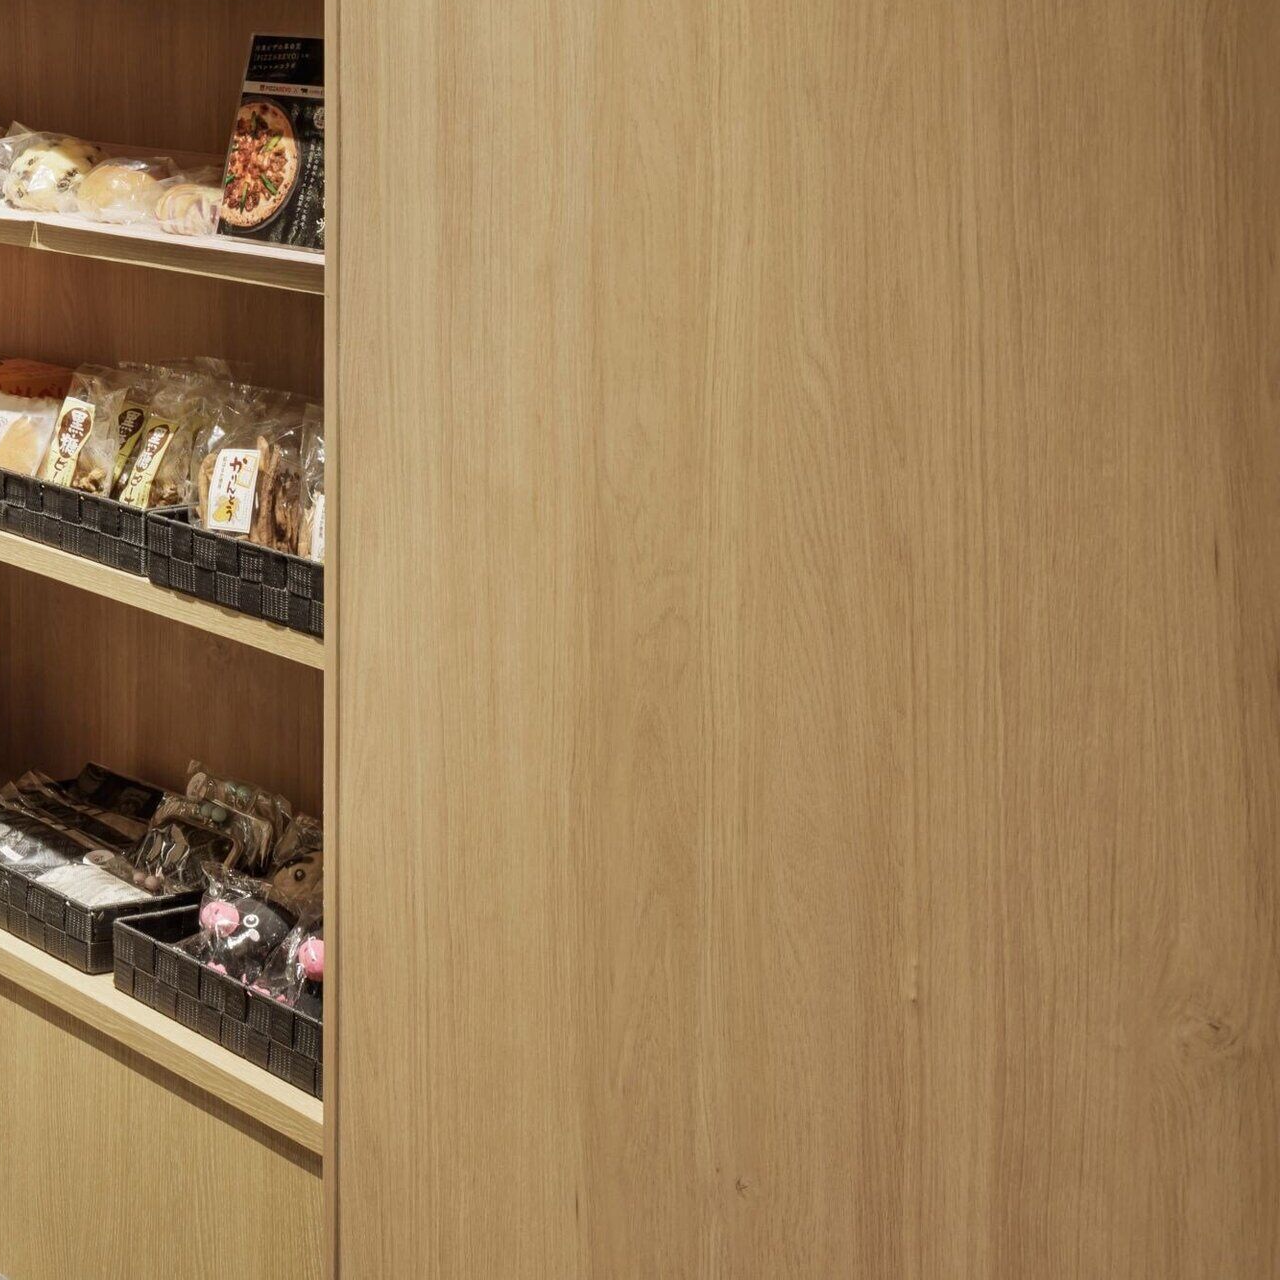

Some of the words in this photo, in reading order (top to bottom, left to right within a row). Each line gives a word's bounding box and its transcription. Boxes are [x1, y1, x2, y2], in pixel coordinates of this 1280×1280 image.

[226, 456, 243, 522] かりんとう
